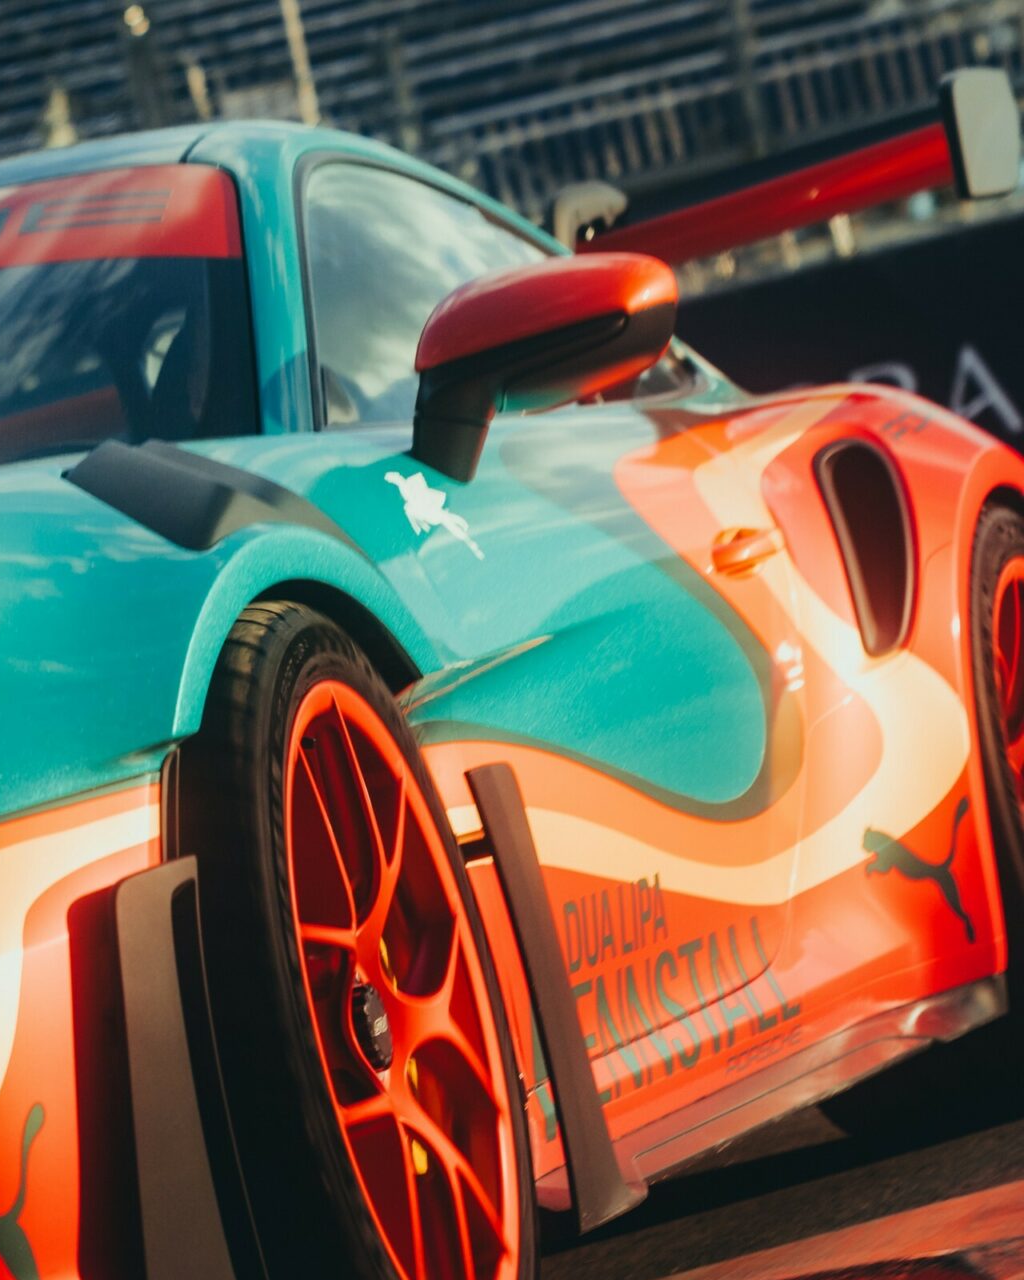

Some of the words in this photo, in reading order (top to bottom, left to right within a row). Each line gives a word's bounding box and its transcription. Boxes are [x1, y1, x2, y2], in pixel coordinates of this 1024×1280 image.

[563, 889, 617, 974] DUA
[618, 870, 669, 956] LIPA
[531, 917, 802, 1143] ENNSTALL
